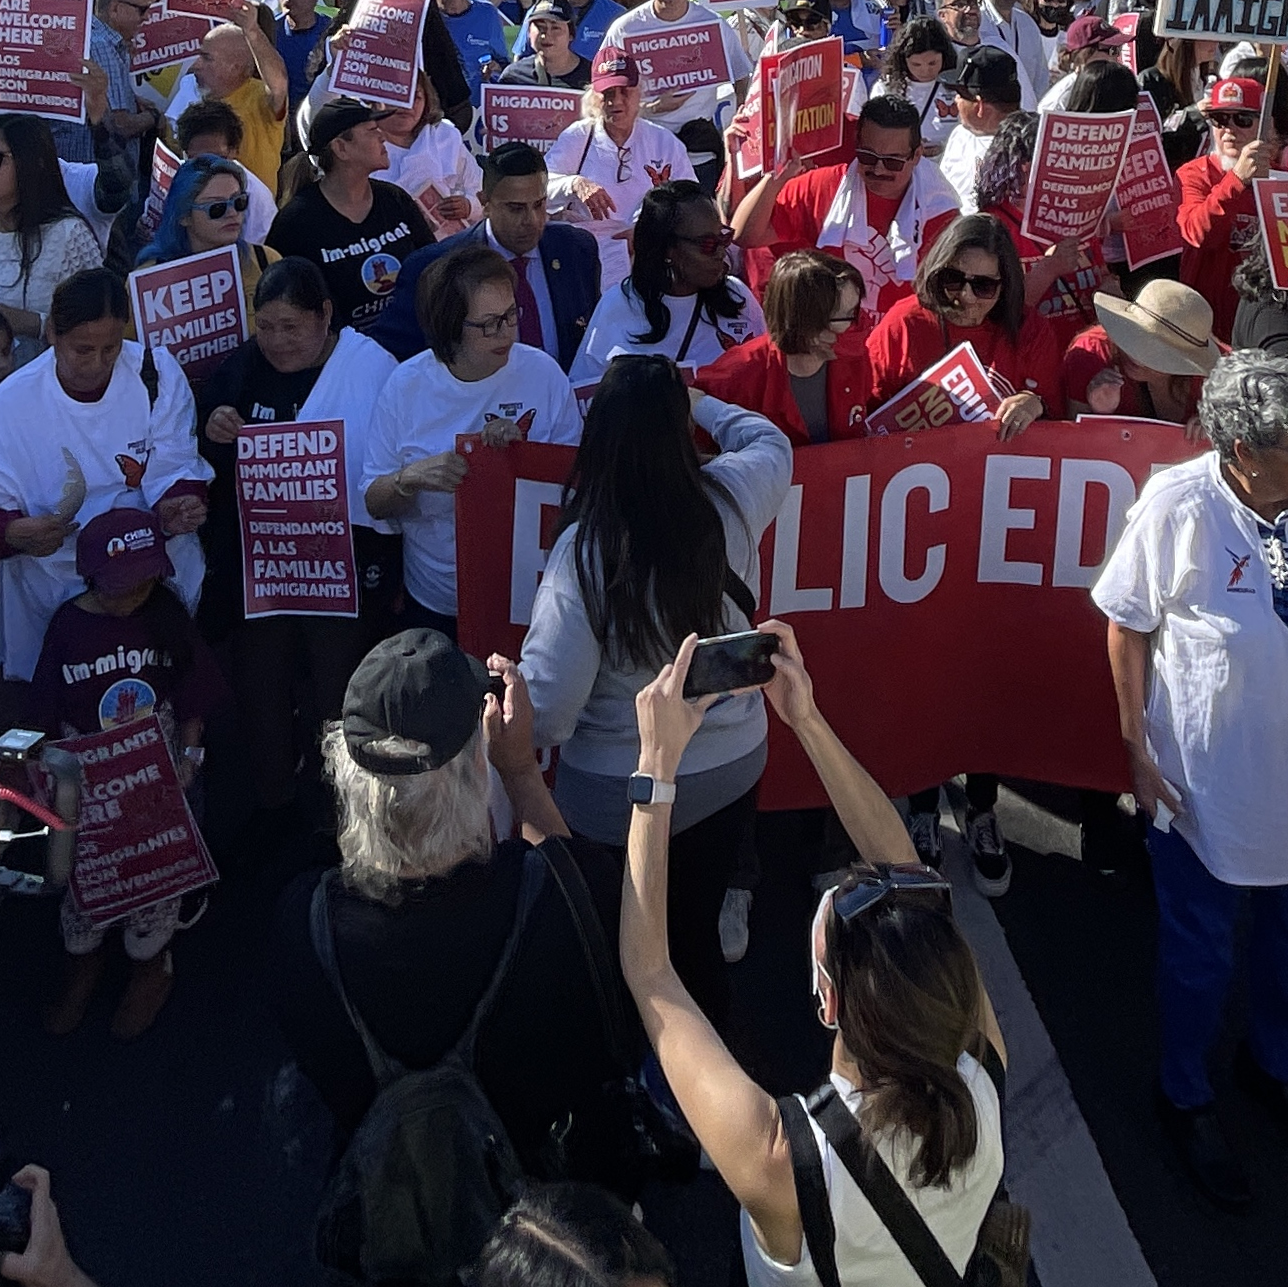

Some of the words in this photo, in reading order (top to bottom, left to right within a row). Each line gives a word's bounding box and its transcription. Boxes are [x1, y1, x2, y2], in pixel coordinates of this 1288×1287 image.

[133, 39, 202, 66] BEAUTIFUL
[349, 37, 367, 50] LOS
[632, 31, 711, 54] MIGRATION
[343, 61, 369, 75] SON
[346, 50, 411, 72] INMIGRANTES
[635, 58, 654, 75] IS
[340, 73, 409, 95] BIENVENIDOS
[640, 68, 718, 93] BEAUTIFUL
[0, 93, 79, 109] BIENVENIDOS
[492, 95, 575, 111] MIGRATION
[492, 114, 509, 132] IS
[793, 101, 836, 135] TATION
[1051, 121, 1125, 141] DEFEND
[1048, 140, 1121, 155] IMMIGRANT
[1046, 153, 1118, 171] FAMILIES
[1120, 148, 1160, 185] EEP
[1042, 179, 1113, 195] DEFENDAMOS
[1118, 175, 1167, 206] FAMILIES
[1039, 194, 1050, 204] A
[1054, 195, 1079, 209] LAS
[1130, 193, 1174, 217] GETHER
[1037, 205, 1104, 226] FAMILIAS
[321, 221, 412, 264] I'm-migrant
[142, 269, 234, 324] KEEP
[351, 295, 396, 319] CHIR
[148, 308, 238, 350] FAMILIES
[173, 333, 240, 366] GETHER
[918, 384, 955, 428] NO
[237, 430, 338, 459] DEFEND
[239, 459, 338, 479] IMMIGRANT
[242, 479, 338, 501] FAMILIES
[249, 521, 345, 535] DEFENDAMOS
[252, 540, 265, 554] A
[269, 541, 297, 555] LAS
[510, 463, 951, 626] PLIC
[254, 560, 347, 580] FAMILIAS
[255, 584, 351, 598] INMIGRANTES
[79, 727, 160, 764] GRANTS
[83, 763, 161, 800] COME
[76, 824, 188, 873] NMIGRANTES
